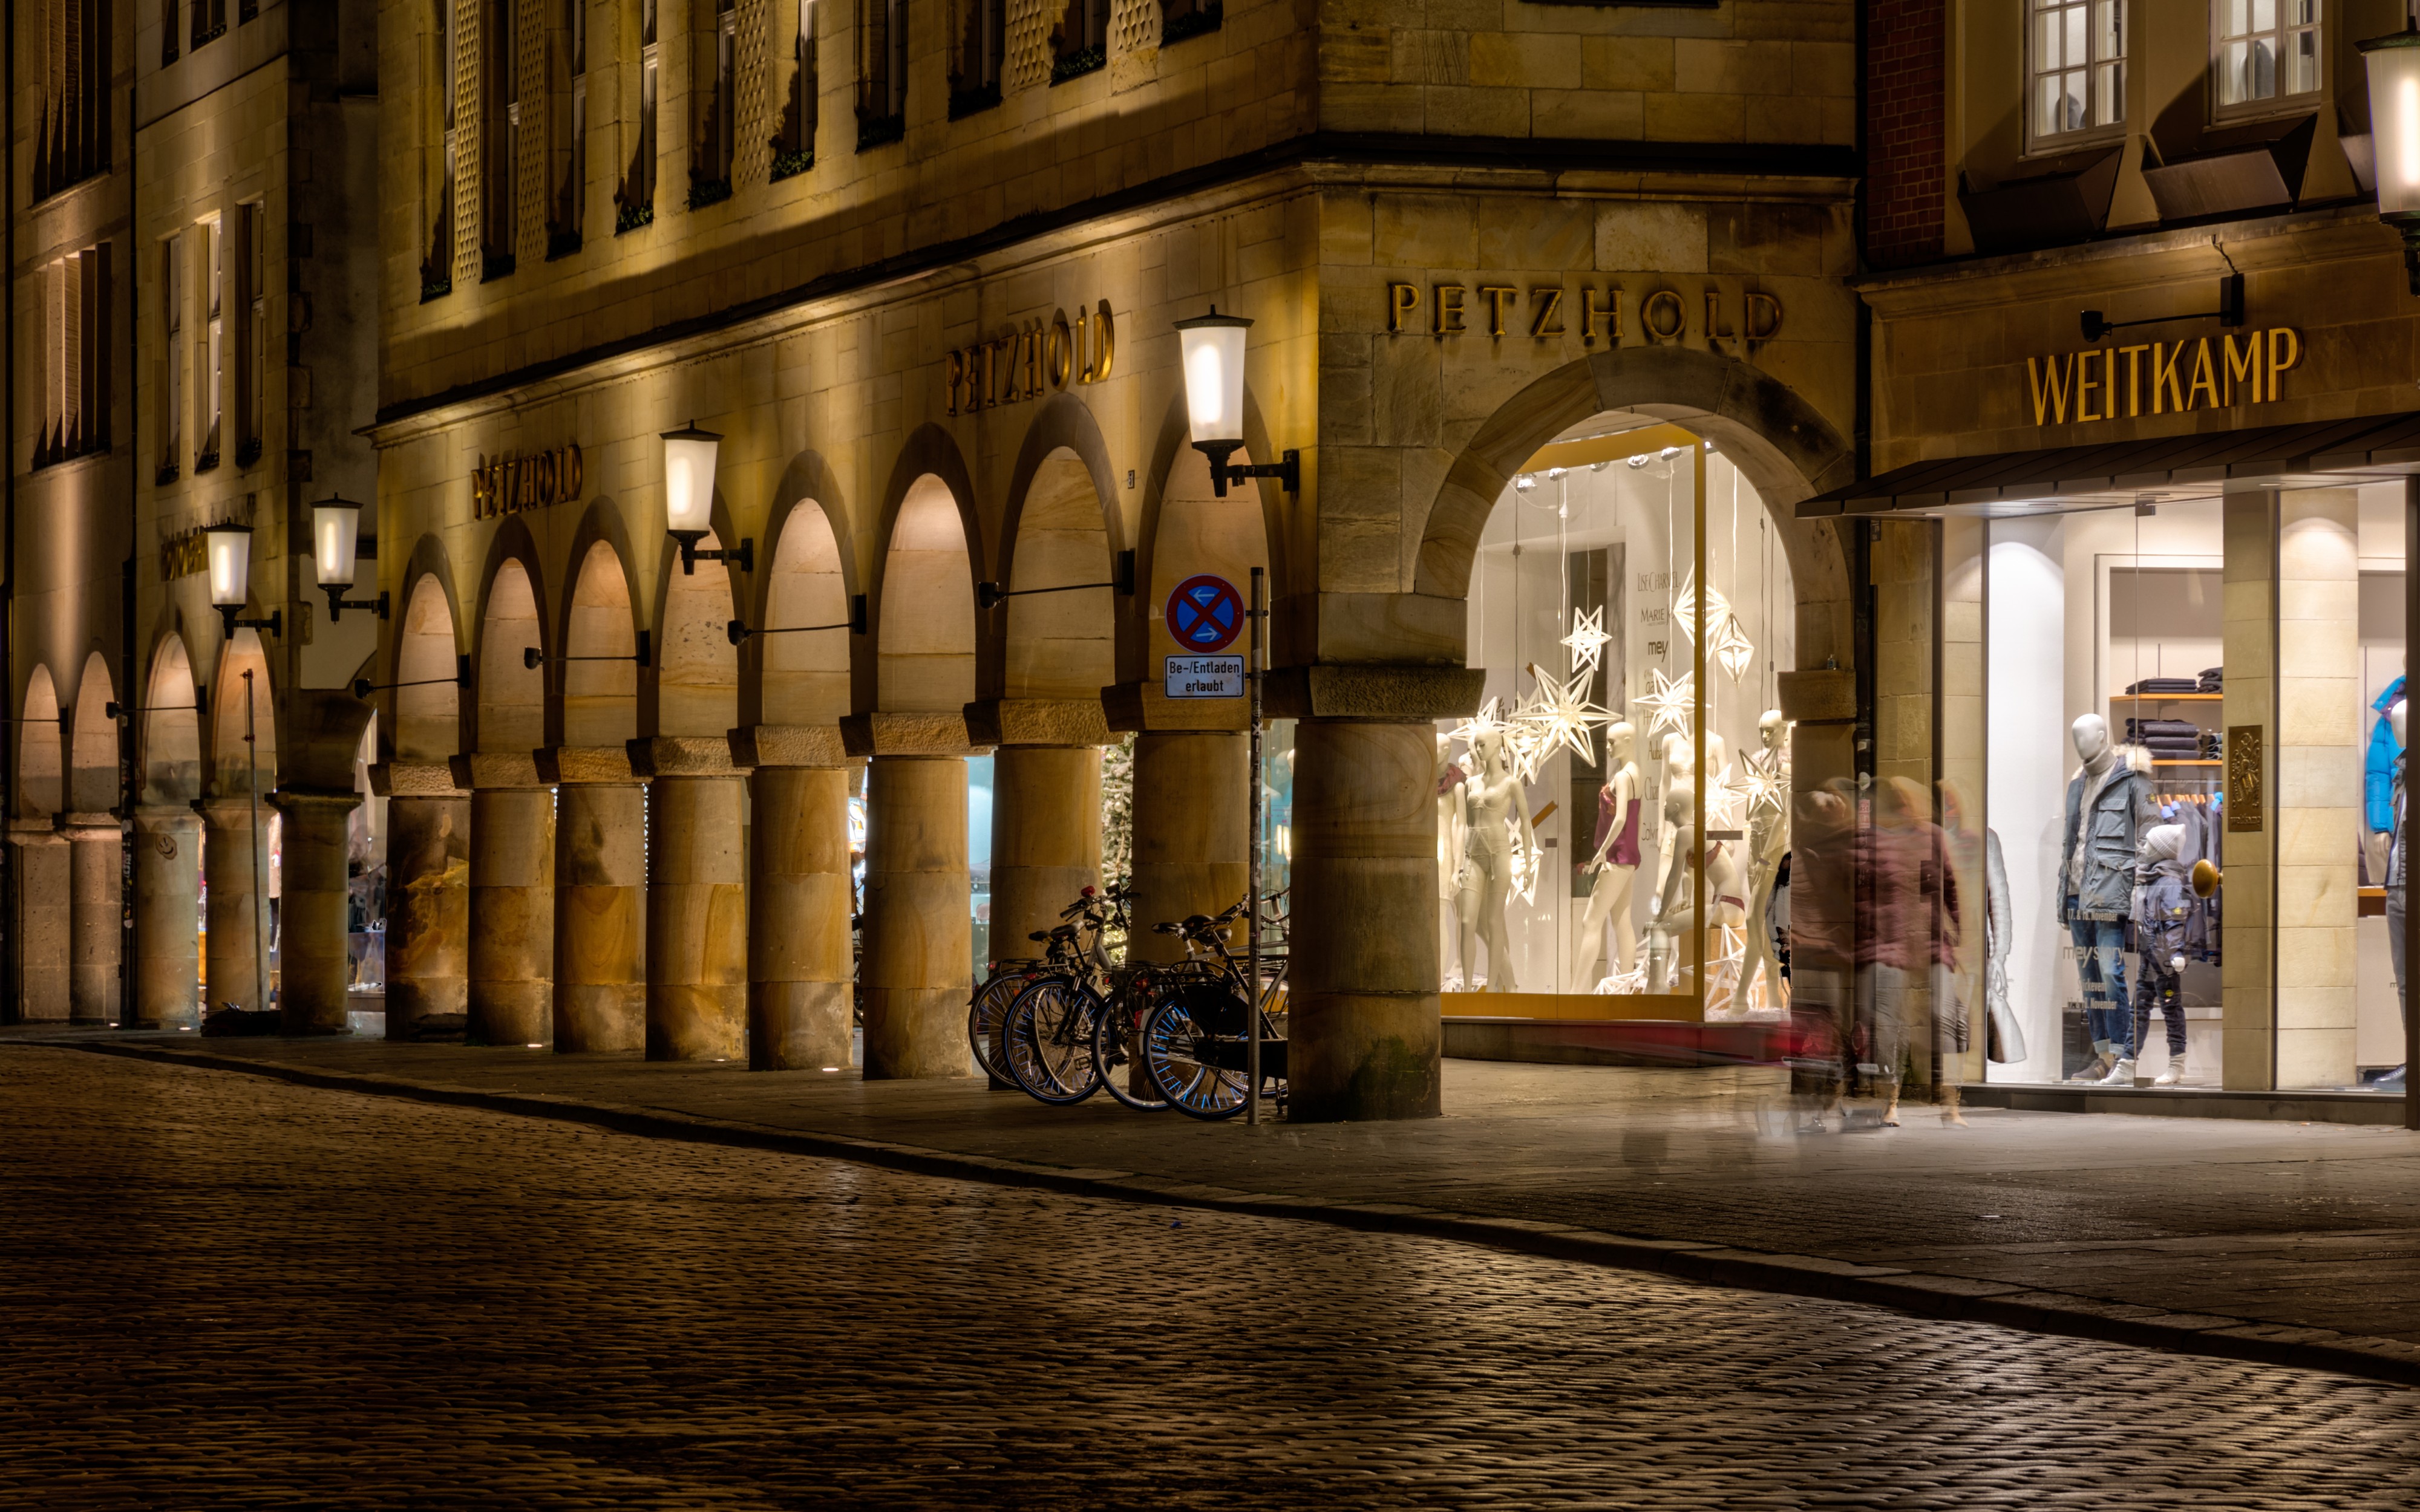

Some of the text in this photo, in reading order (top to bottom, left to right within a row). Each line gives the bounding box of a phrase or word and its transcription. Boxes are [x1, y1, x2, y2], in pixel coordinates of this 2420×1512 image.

[1390, 283, 1784, 341] PETZHOLD
[946, 310, 1114, 416] PETZHOLD
[2027, 327, 2304, 426] WEITKAMP
[471, 444, 583, 521] PETZHOLD
[1640, 607, 1665, 623] MARIE
[1648, 640, 1669, 663] mey
[1169, 661, 1240, 674] Be-/Entladen
[1185, 680, 1224, 692] erlaubt
[2091, 910, 2118, 922] November
[2090, 997, 2118, 1009] November
